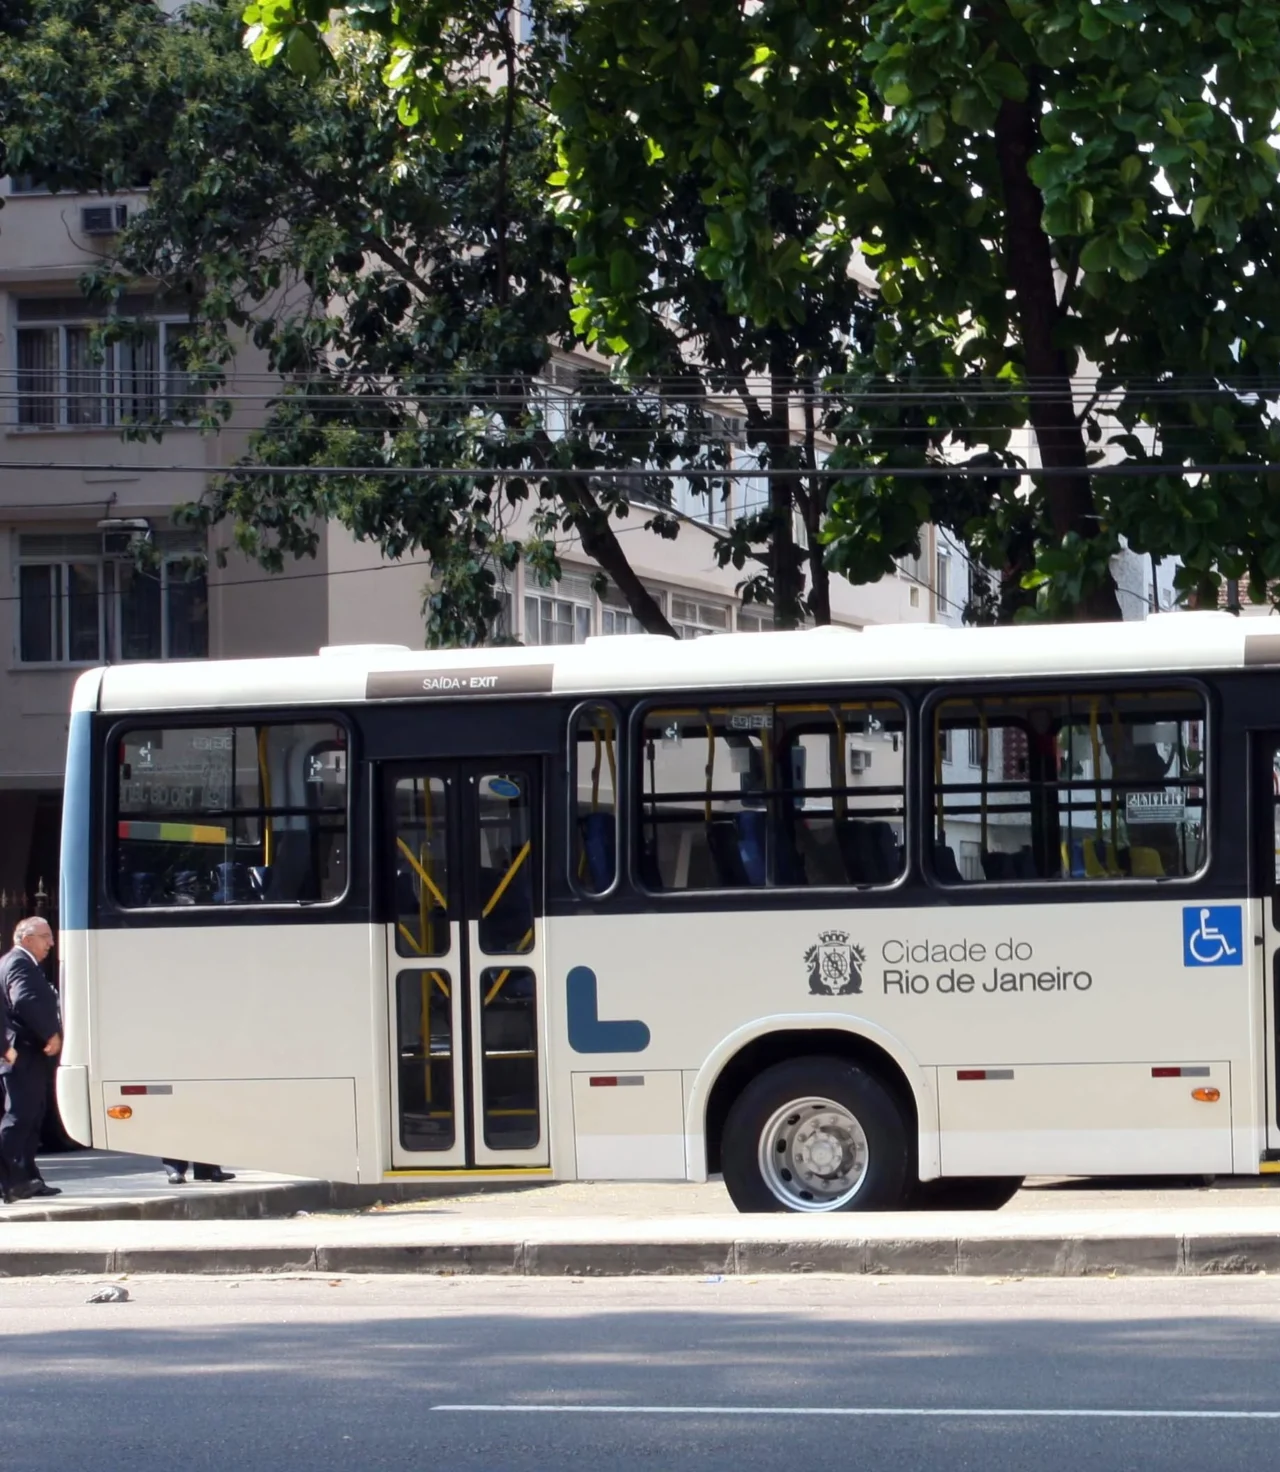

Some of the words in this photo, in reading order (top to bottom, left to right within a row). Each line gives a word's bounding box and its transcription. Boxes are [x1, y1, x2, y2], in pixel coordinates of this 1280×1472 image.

[422, 676, 460, 690] SAÍDA
[470, 675, 499, 689] EXIT
[881, 938, 987, 964] Cidade
[995, 937, 1033, 962] do
[882, 969, 930, 995] Rio
[935, 968, 976, 993] de
[982, 966, 1093, 993] Janeiro
